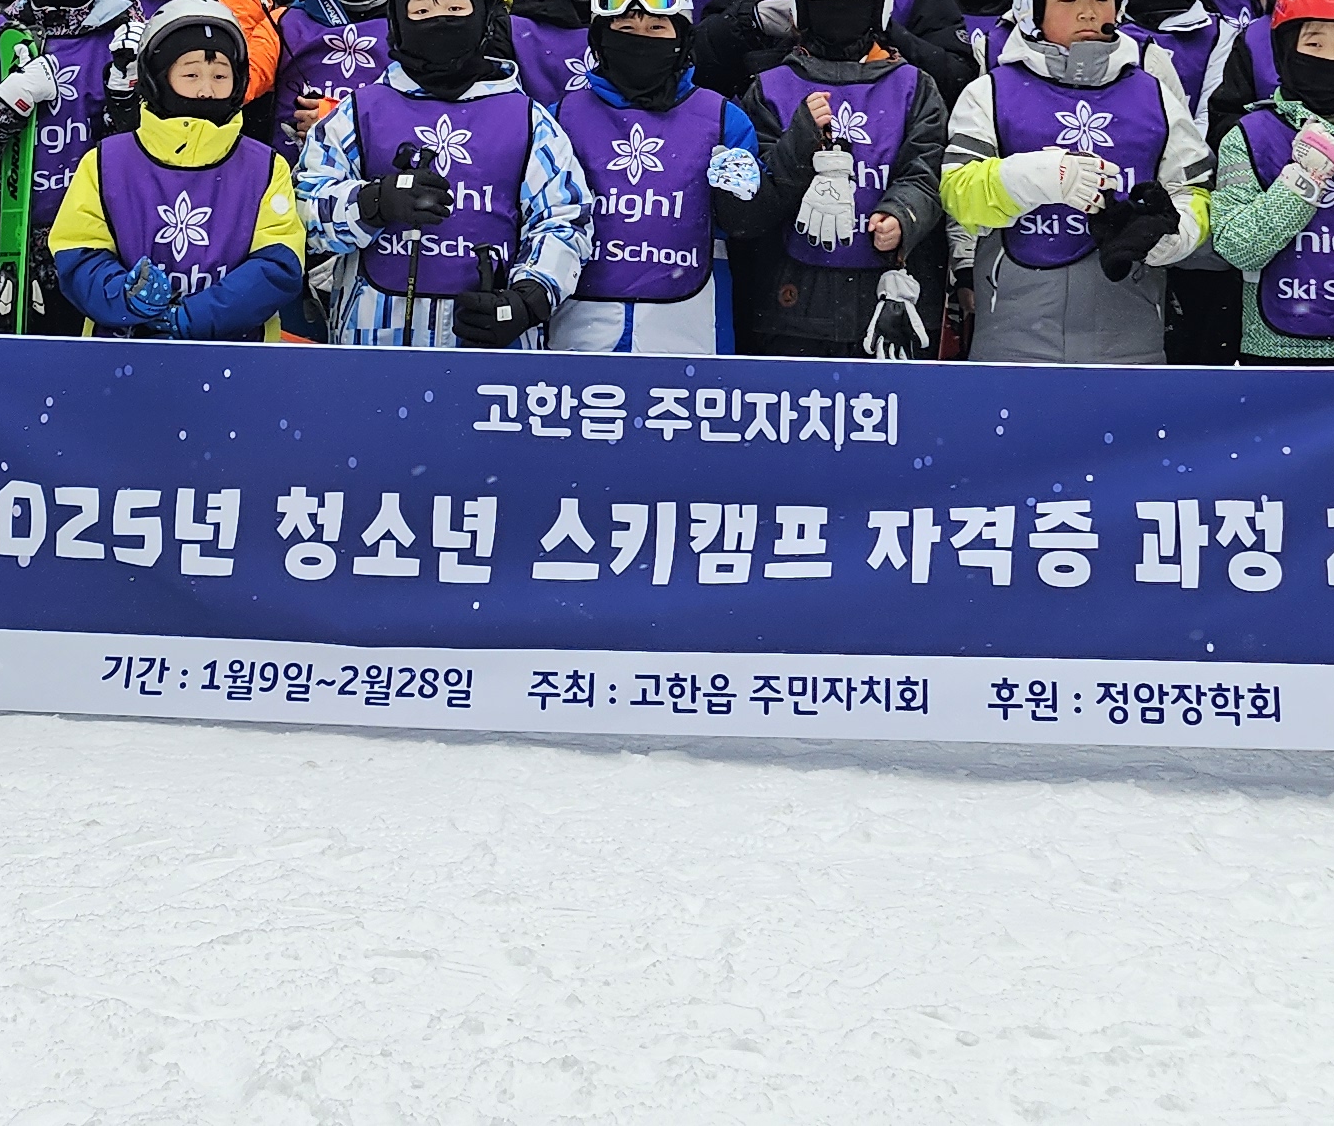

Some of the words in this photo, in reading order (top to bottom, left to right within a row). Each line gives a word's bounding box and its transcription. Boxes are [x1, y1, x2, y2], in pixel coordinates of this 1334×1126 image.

[1019, 214, 1060, 235] Ski
[606, 239, 699, 268] School
[1277, 277, 1317, 300] Ski
[473, 382, 627, 440] 고한읍
[644, 387, 898, 447] 주민자치회
[276, 486, 498, 584] 청소년
[531, 497, 833, 585] 스키캠프
[866, 499, 1099, 588] 자격증
[1135, 498, 1284, 592] 과정
[101, 655, 171, 696] 기간
[200, 659, 473, 709] 1월9일~2월28일
[527, 669, 595, 711] 주최
[629, 672, 738, 715] 고한읍
[748, 675, 929, 716] 주민자치회
[987, 677, 1059, 722] 후원
[1095, 682, 1282, 727] 정암장학회
